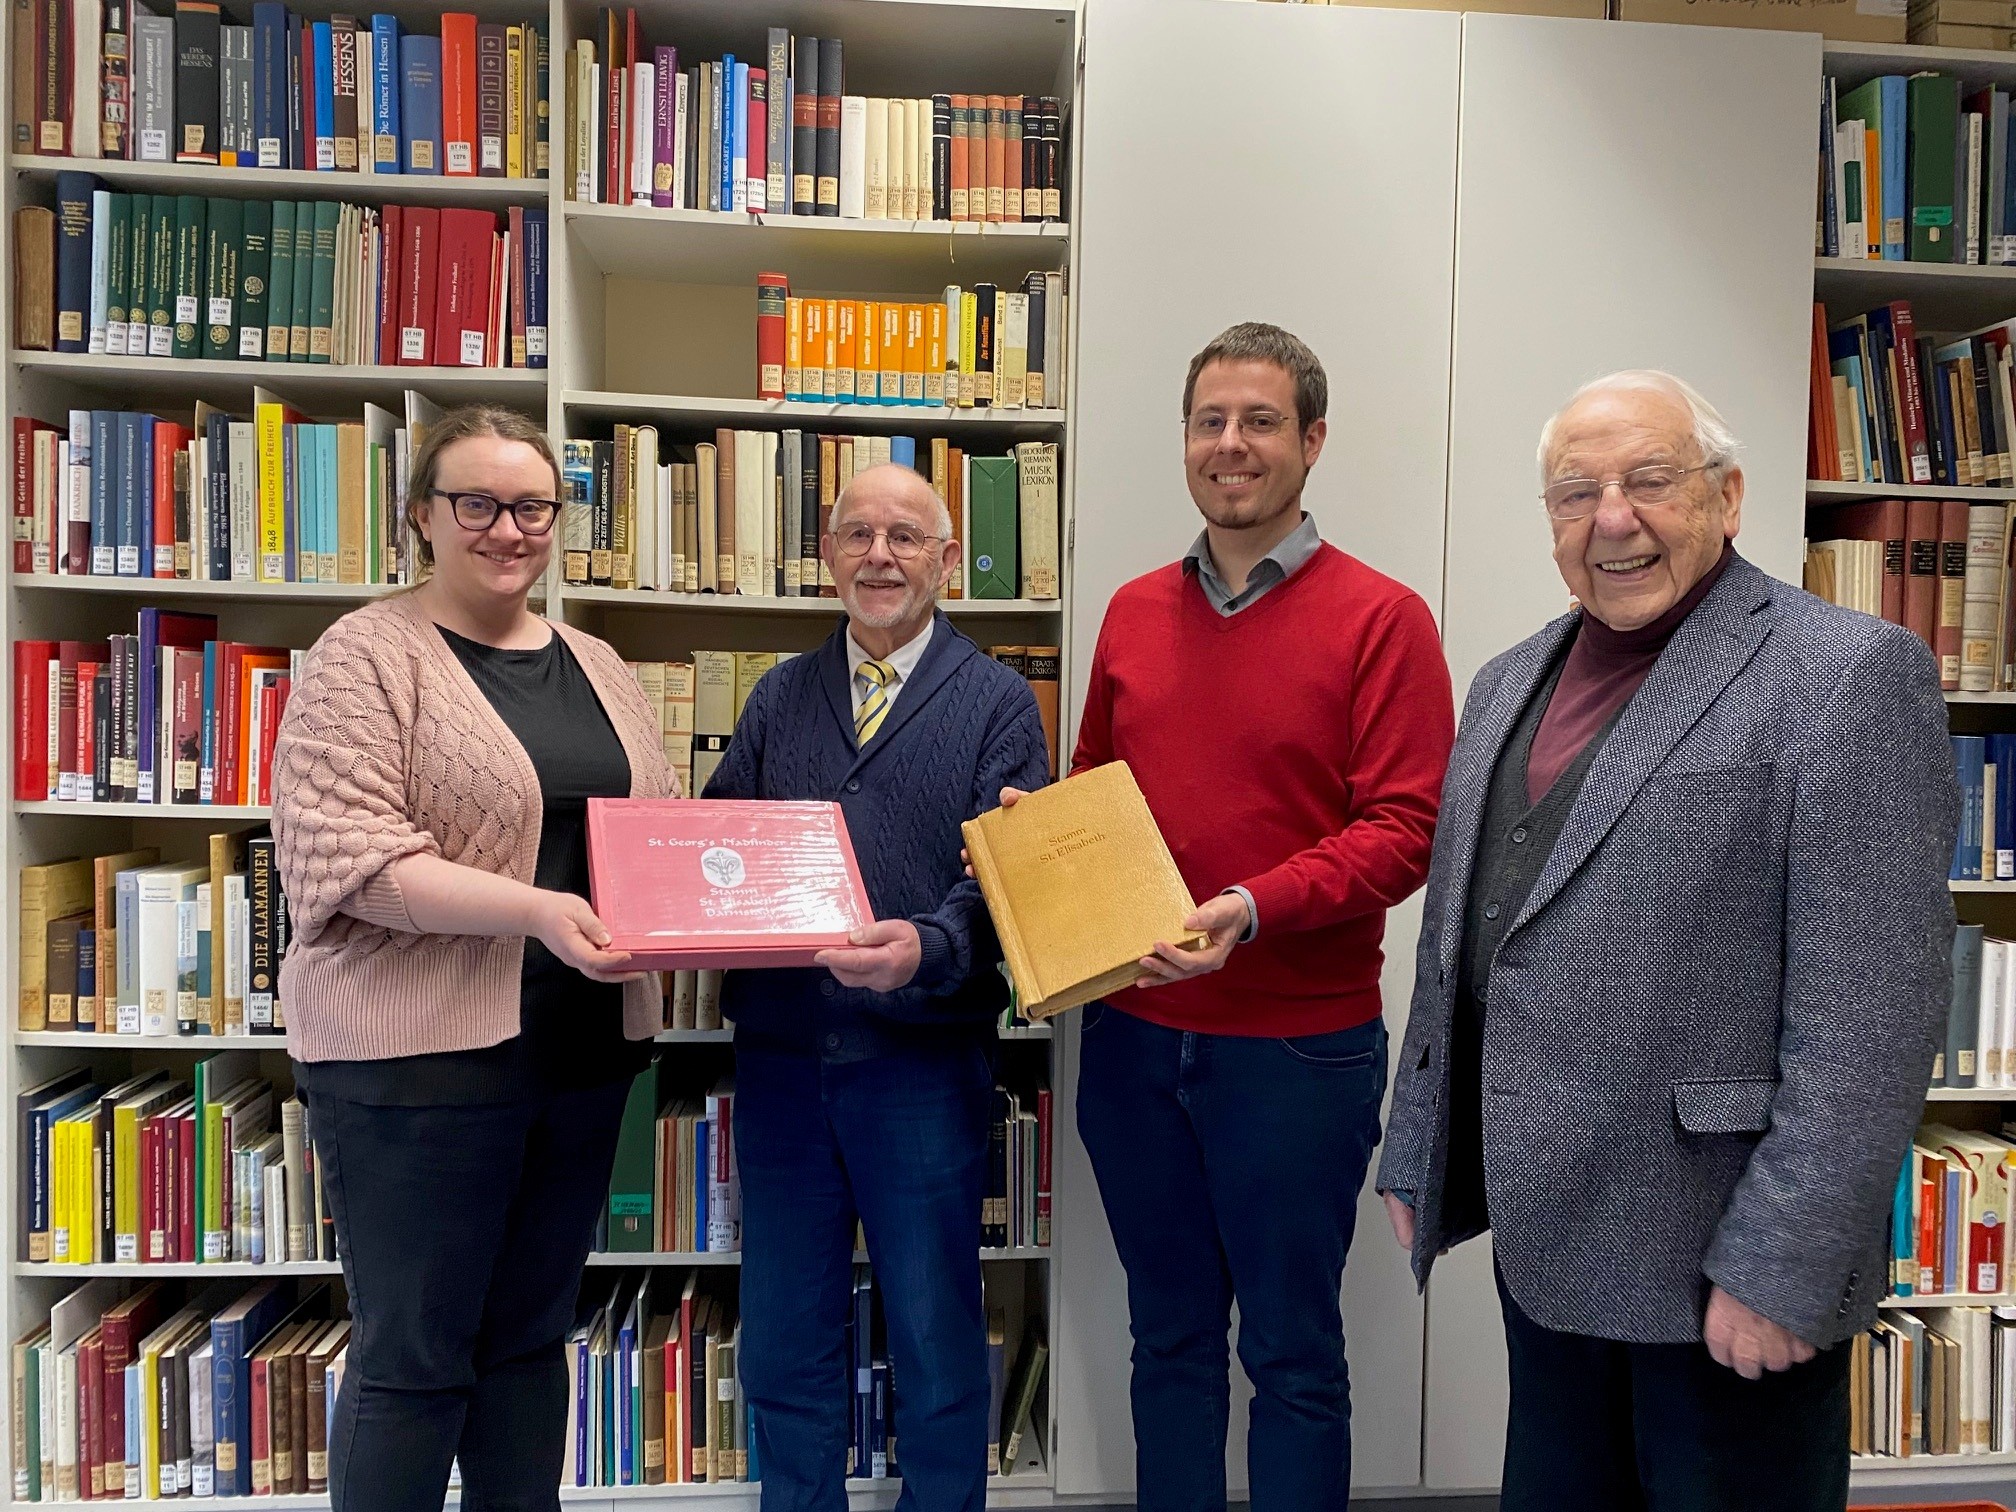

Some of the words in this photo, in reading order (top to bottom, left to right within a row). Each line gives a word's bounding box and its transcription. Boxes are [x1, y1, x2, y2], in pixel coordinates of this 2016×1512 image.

[48, 57, 56, 70] DES
[340, 32, 355, 97] HESSENS
[376, 38, 388, 71] Hessen
[772, 43, 784, 71] TSAR
[378, 74, 388, 83] in
[659, 54, 667, 91] LUDWIG
[611, 75, 619, 93] Lust
[147, 103, 153, 111] IM
[378, 85, 388, 118] Römer
[659, 93, 667, 126] ERNST
[611, 95, 619, 129] Ludwigs
[379, 120, 388, 135] Die
[966, 321, 971, 329] IN
[981, 316, 989, 348] Kunstführer
[266, 420, 275, 457] FREIHEIT
[1021, 447, 1055, 455] BROCKHAUS
[1024, 466, 1052, 474] MUSIK
[1021, 477, 1055, 485] LEXIKON
[73, 467, 82, 520] FRANKREICH
[266, 479, 275, 525] AUFBRUCH
[19, 504, 25, 513] Im
[267, 530, 276, 551] 1848
[614, 513, 626, 548] Wallis
[1001, 657, 1023, 665] STAATS
[1028, 667, 1056, 675] LEXIKON
[1031, 660, 1054, 668] STAATS
[713, 739, 716, 747] 1
[648, 838, 664, 846] St.
[723, 838, 786, 846] Pfadfinder
[1050, 828, 1086, 847] Stamm
[1040, 852, 1055, 864] St.
[1058, 834, 1106, 857] Elisabeth
[254, 848, 268, 939] ALAMANNEN
[699, 898, 716, 906] St.
[710, 888, 758, 896] Stamm
[277, 893, 285, 915] Hessen
[277, 924, 285, 953] Romanik
[254, 942, 268, 968] DIE
